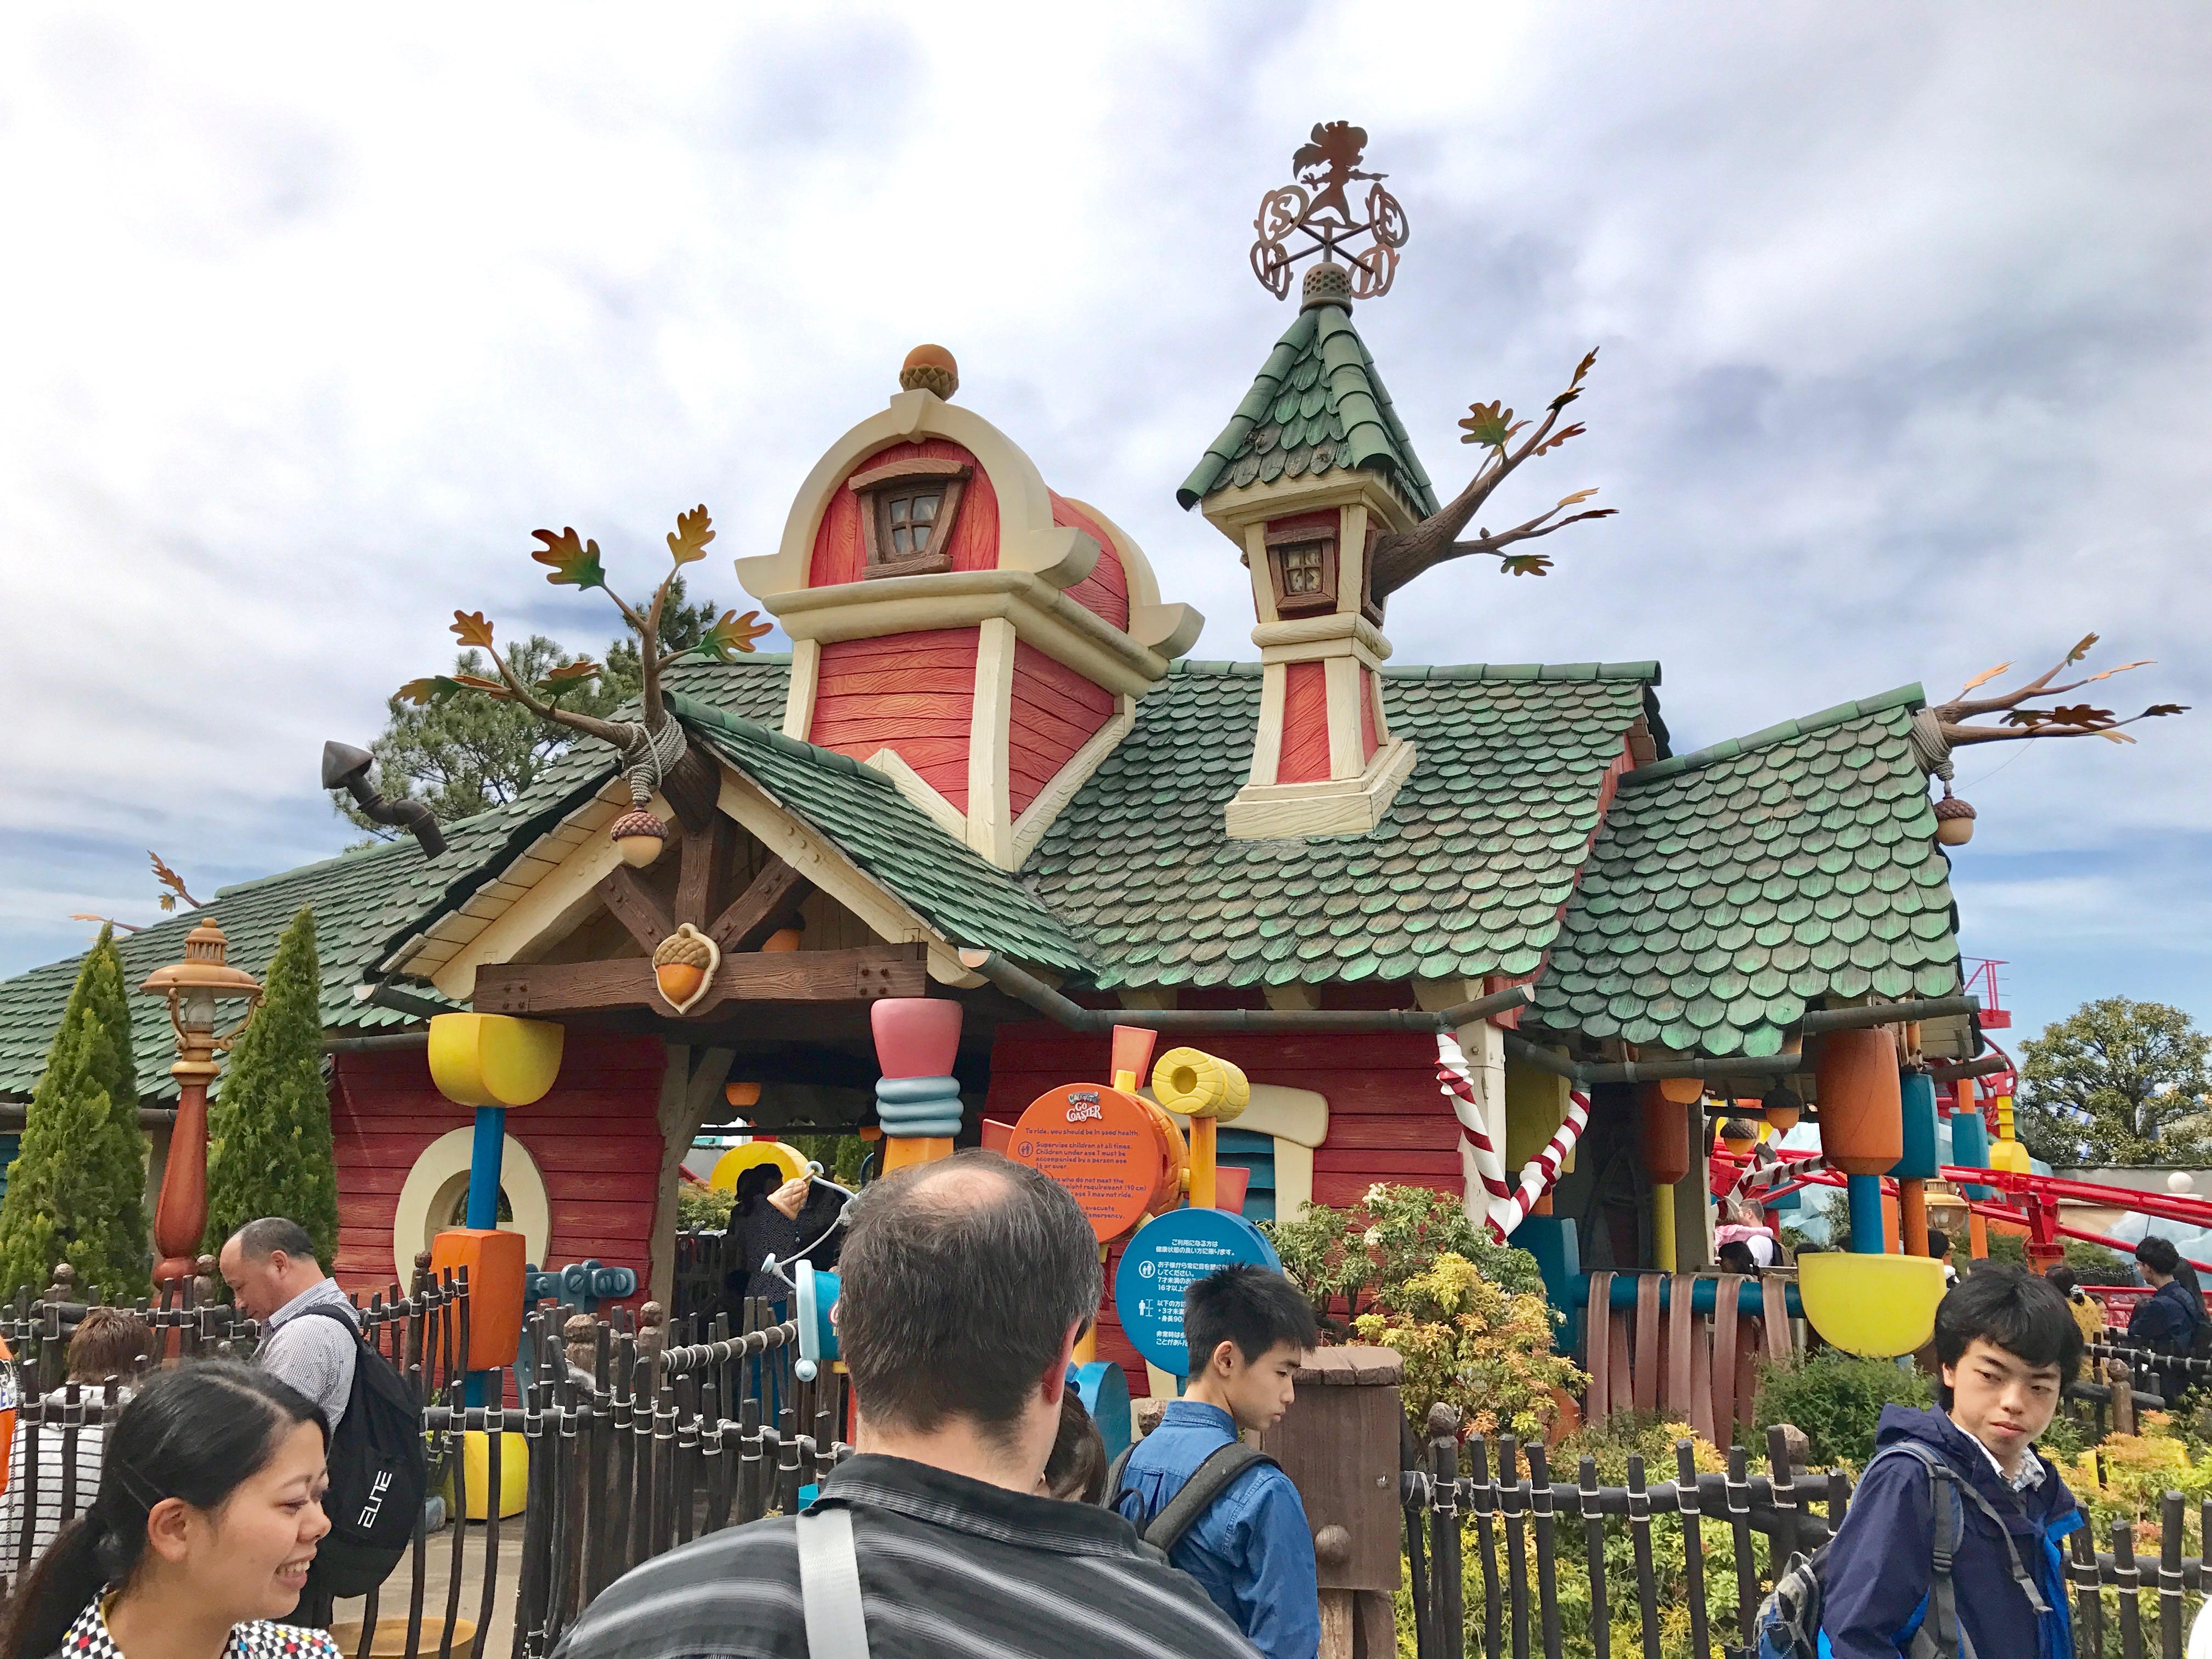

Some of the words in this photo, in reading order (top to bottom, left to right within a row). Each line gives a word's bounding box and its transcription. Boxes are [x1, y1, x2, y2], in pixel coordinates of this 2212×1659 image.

[1075, 1102, 1087, 1111] GO
[1066, 1105, 1103, 1122] COASTER
[1171, 1239, 1218, 1248] ご利用になる方は
[1157, 1268, 1194, 1277] してください。
